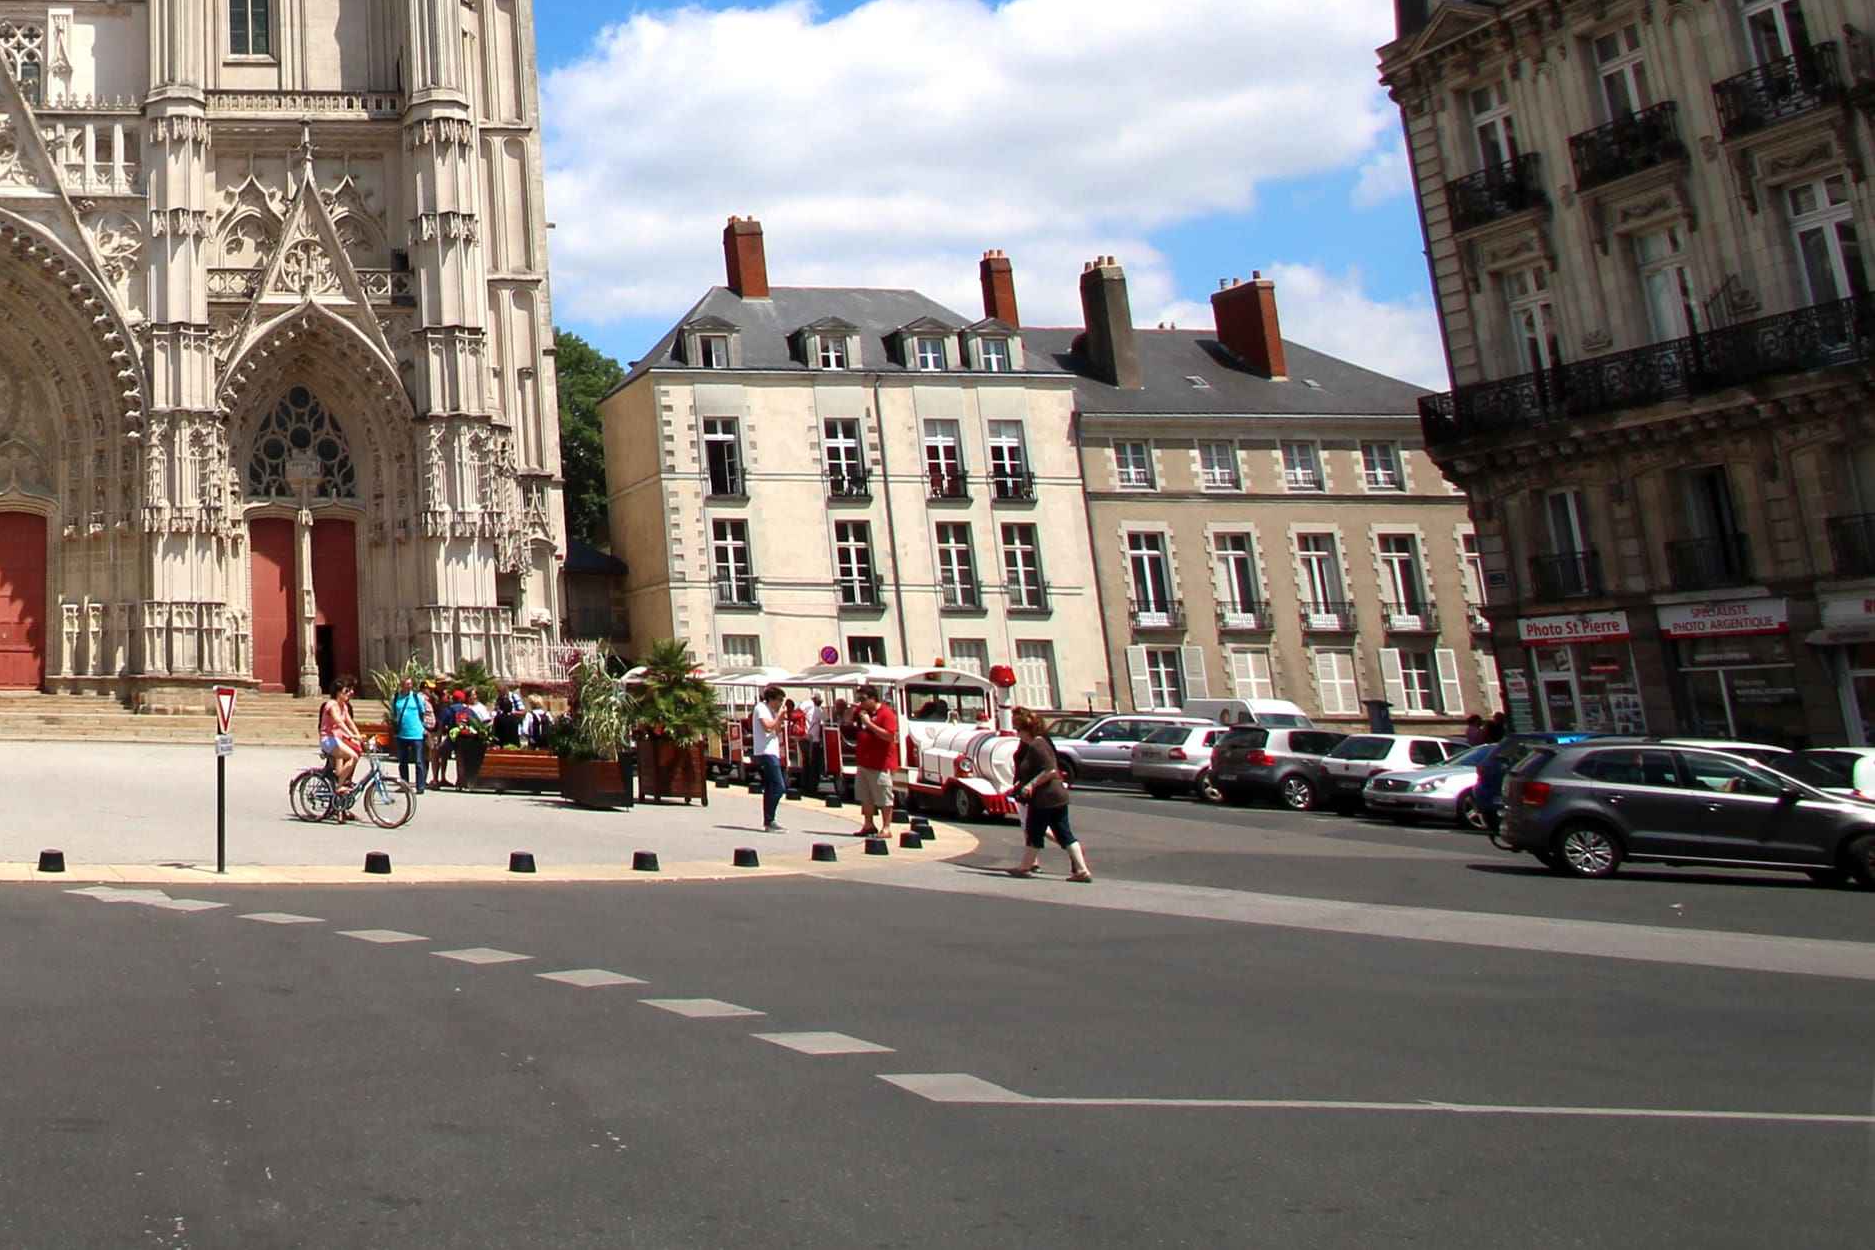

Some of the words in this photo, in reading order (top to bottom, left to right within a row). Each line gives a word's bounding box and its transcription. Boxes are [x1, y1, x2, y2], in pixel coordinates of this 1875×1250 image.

[1526, 622, 1563, 637] Photo
[1565, 621, 1579, 635] St
[1581, 619, 1621, 634] Pierre
[1672, 621, 1705, 632] PHOTO
[1709, 615, 1774, 631] ARGENTIQUE
